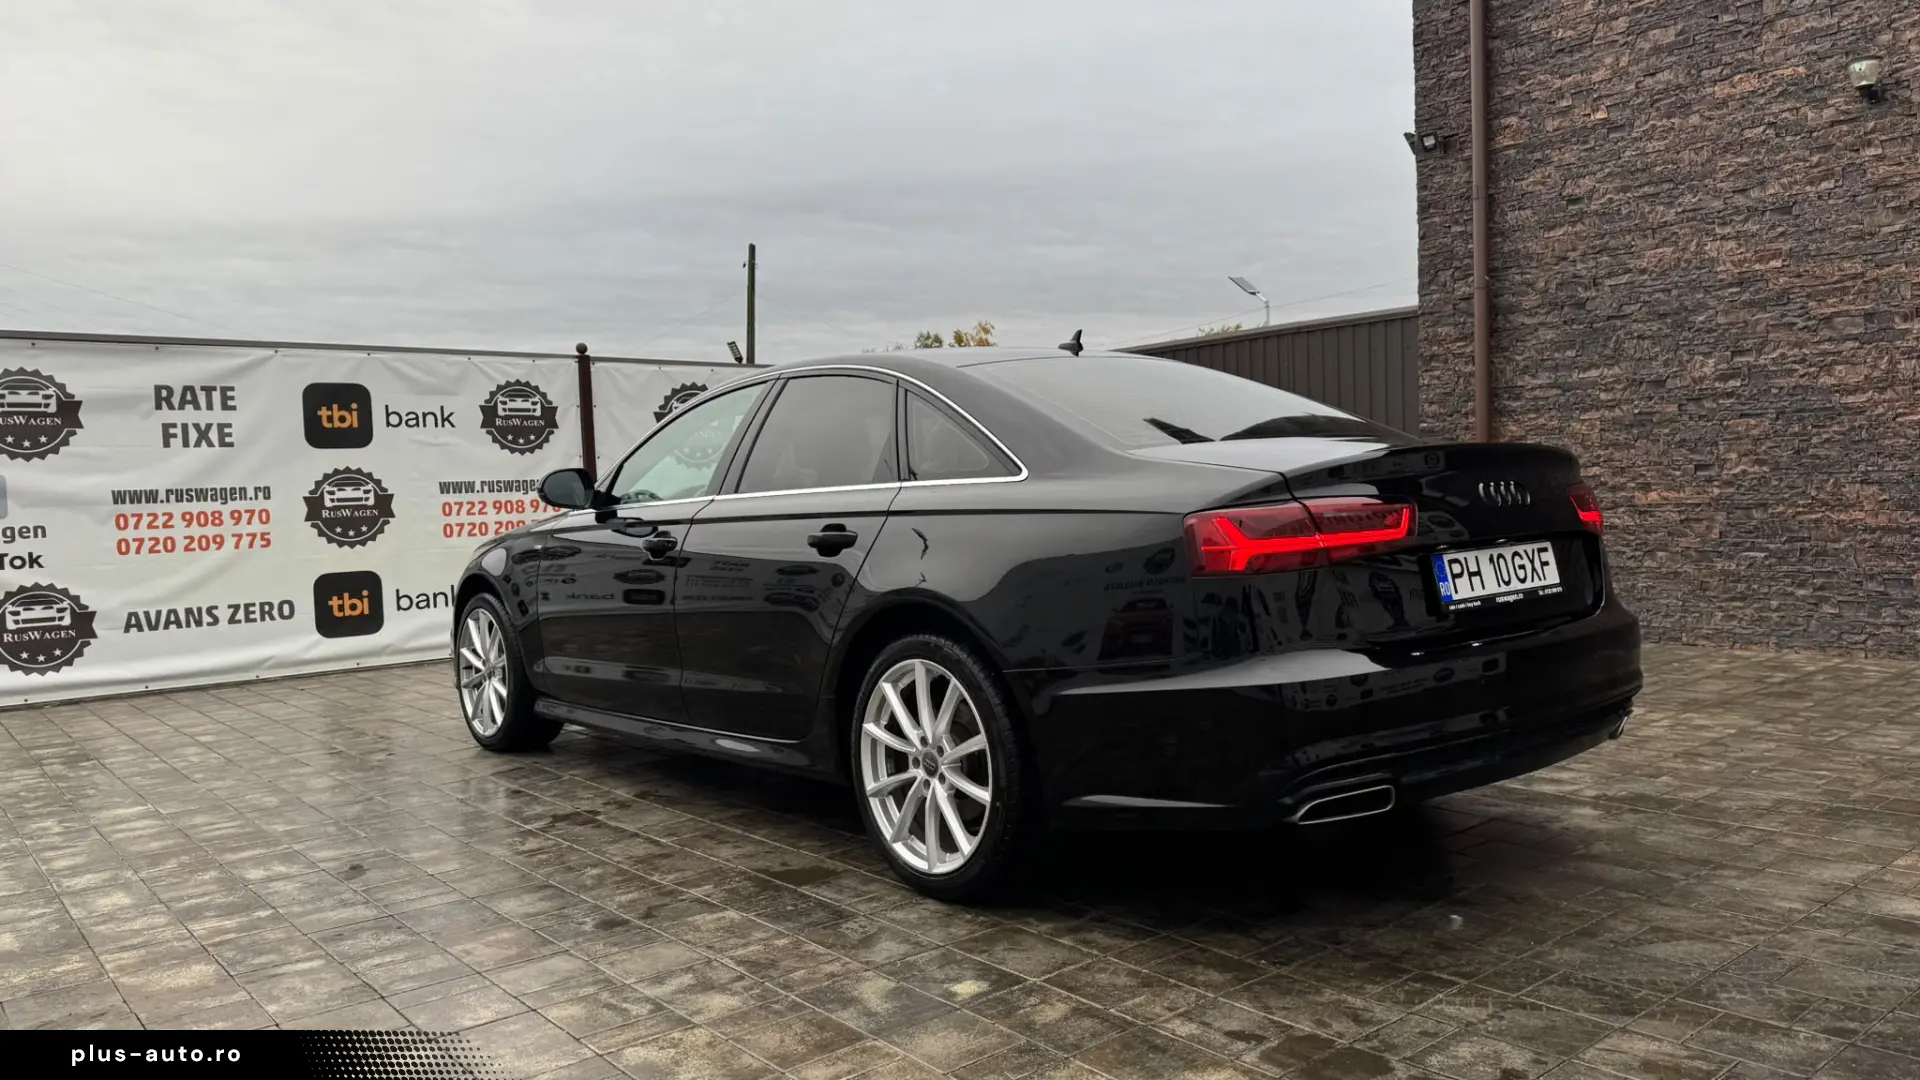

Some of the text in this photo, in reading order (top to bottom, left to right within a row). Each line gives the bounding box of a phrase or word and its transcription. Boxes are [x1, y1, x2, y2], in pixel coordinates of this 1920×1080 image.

[154, 385, 236, 411] RATE
[317, 403, 456, 430] tbi bank
[161, 422, 235, 449] FIXE
[111, 485, 271, 506] www.ruswagen.ro
[439, 479, 541, 495] www.ruswage
[115, 508, 271, 531] 0722 908 970
[441, 501, 488, 517] 0722
[492, 499, 526, 515] 908
[442, 521, 489, 538] 0720
[116, 531, 272, 556] 0720 209 775
[1447, 555, 1485, 595] PH
[124, 599, 296, 634] AVANS ZERO
[329, 590, 370, 618] tbi
